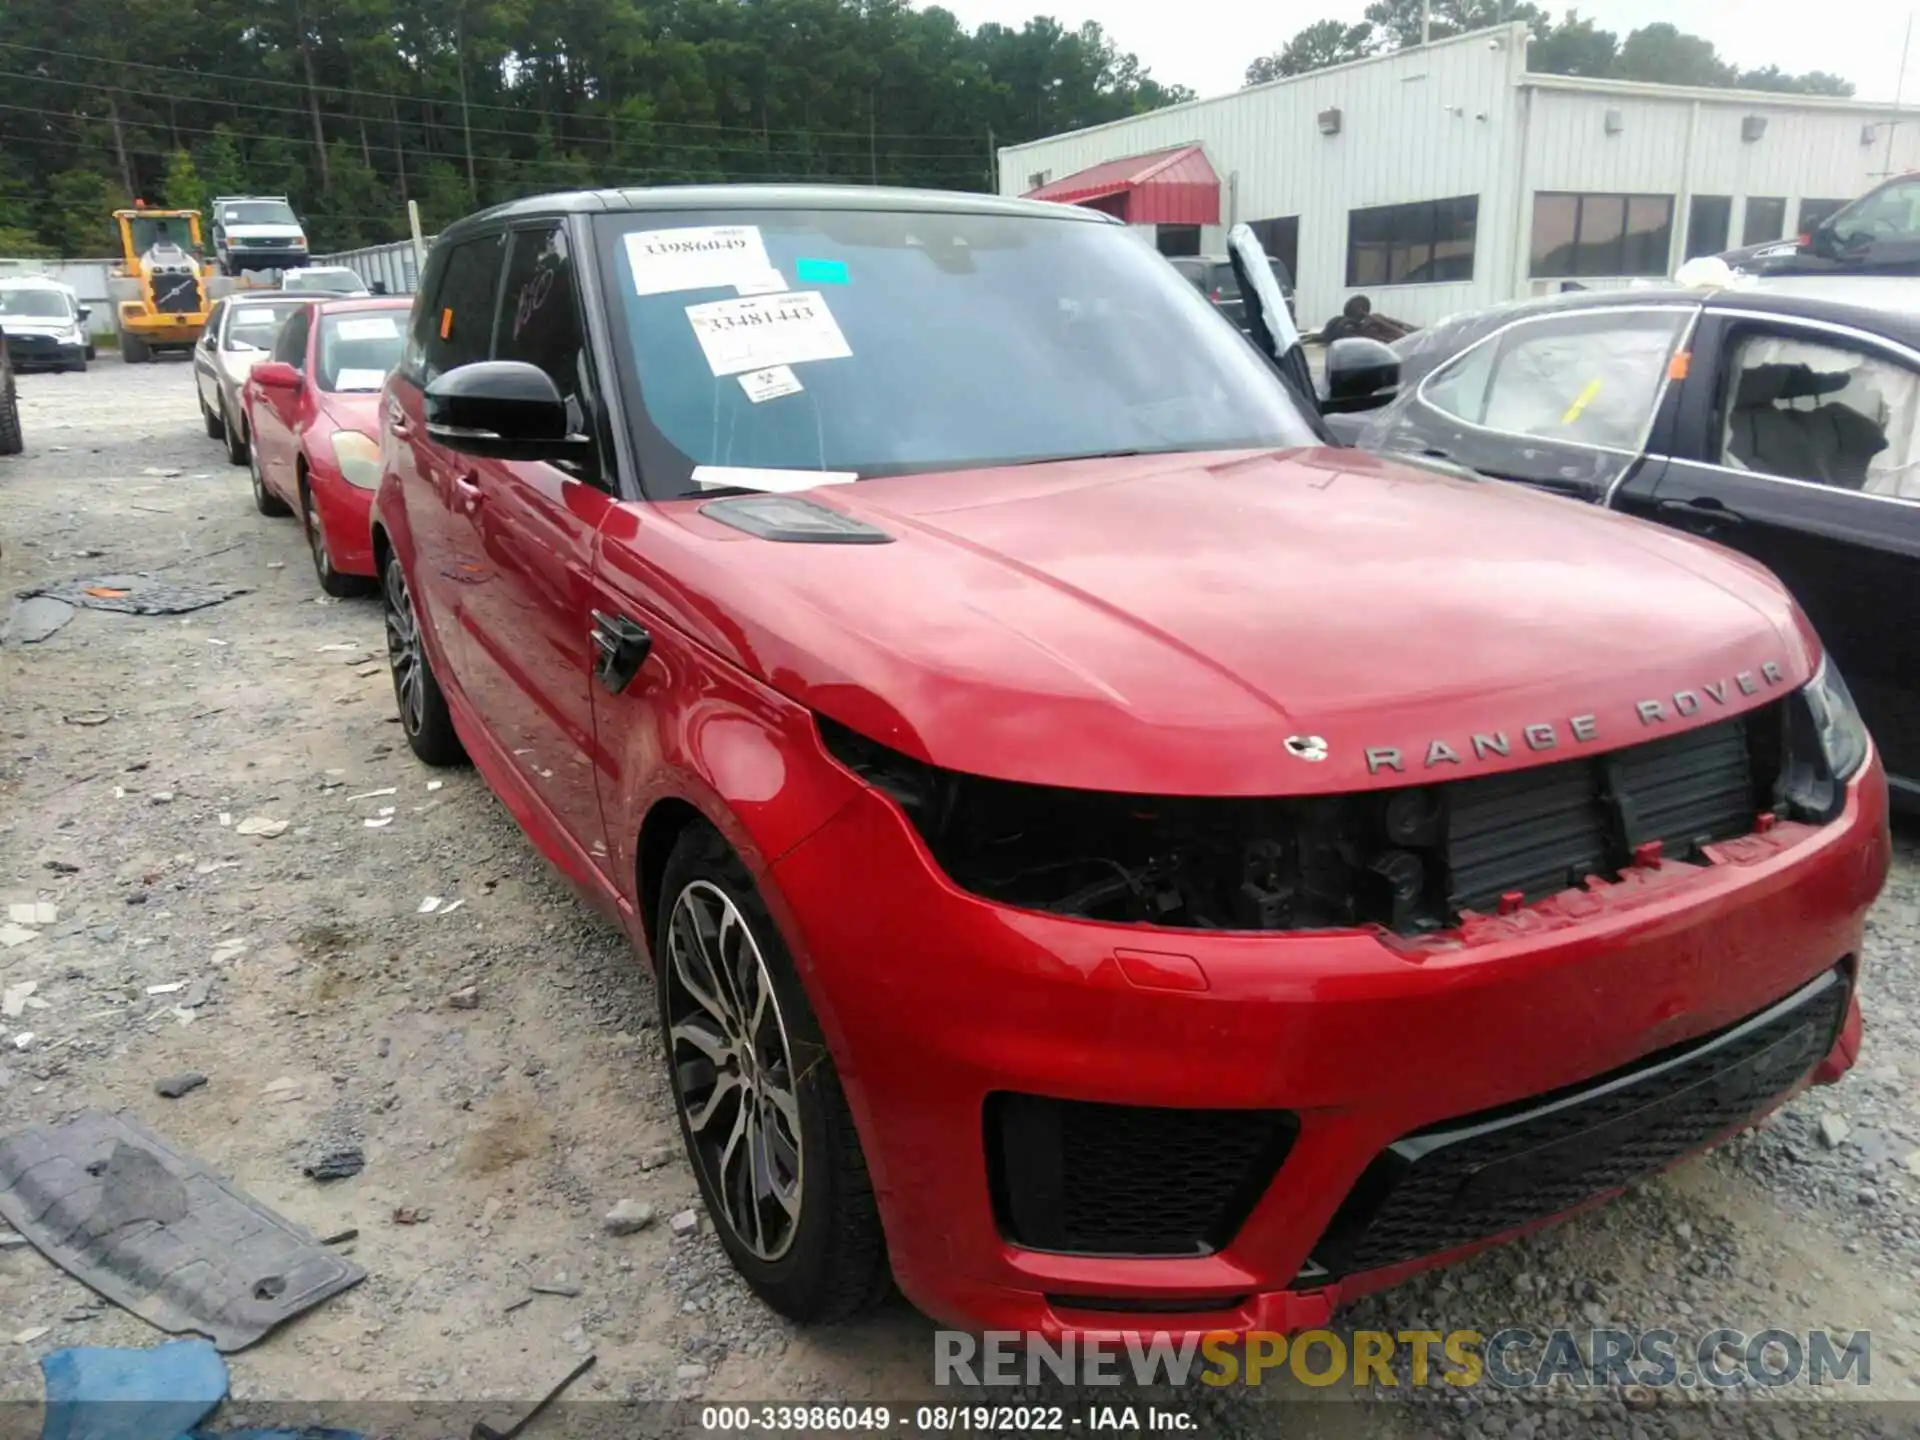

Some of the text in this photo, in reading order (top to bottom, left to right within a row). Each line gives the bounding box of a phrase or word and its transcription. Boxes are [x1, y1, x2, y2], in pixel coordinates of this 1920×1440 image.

[644, 239, 747, 257] 33986049
[709, 306, 814, 332] 33481443
[1364, 660, 1784, 775] RANGE ROVER
